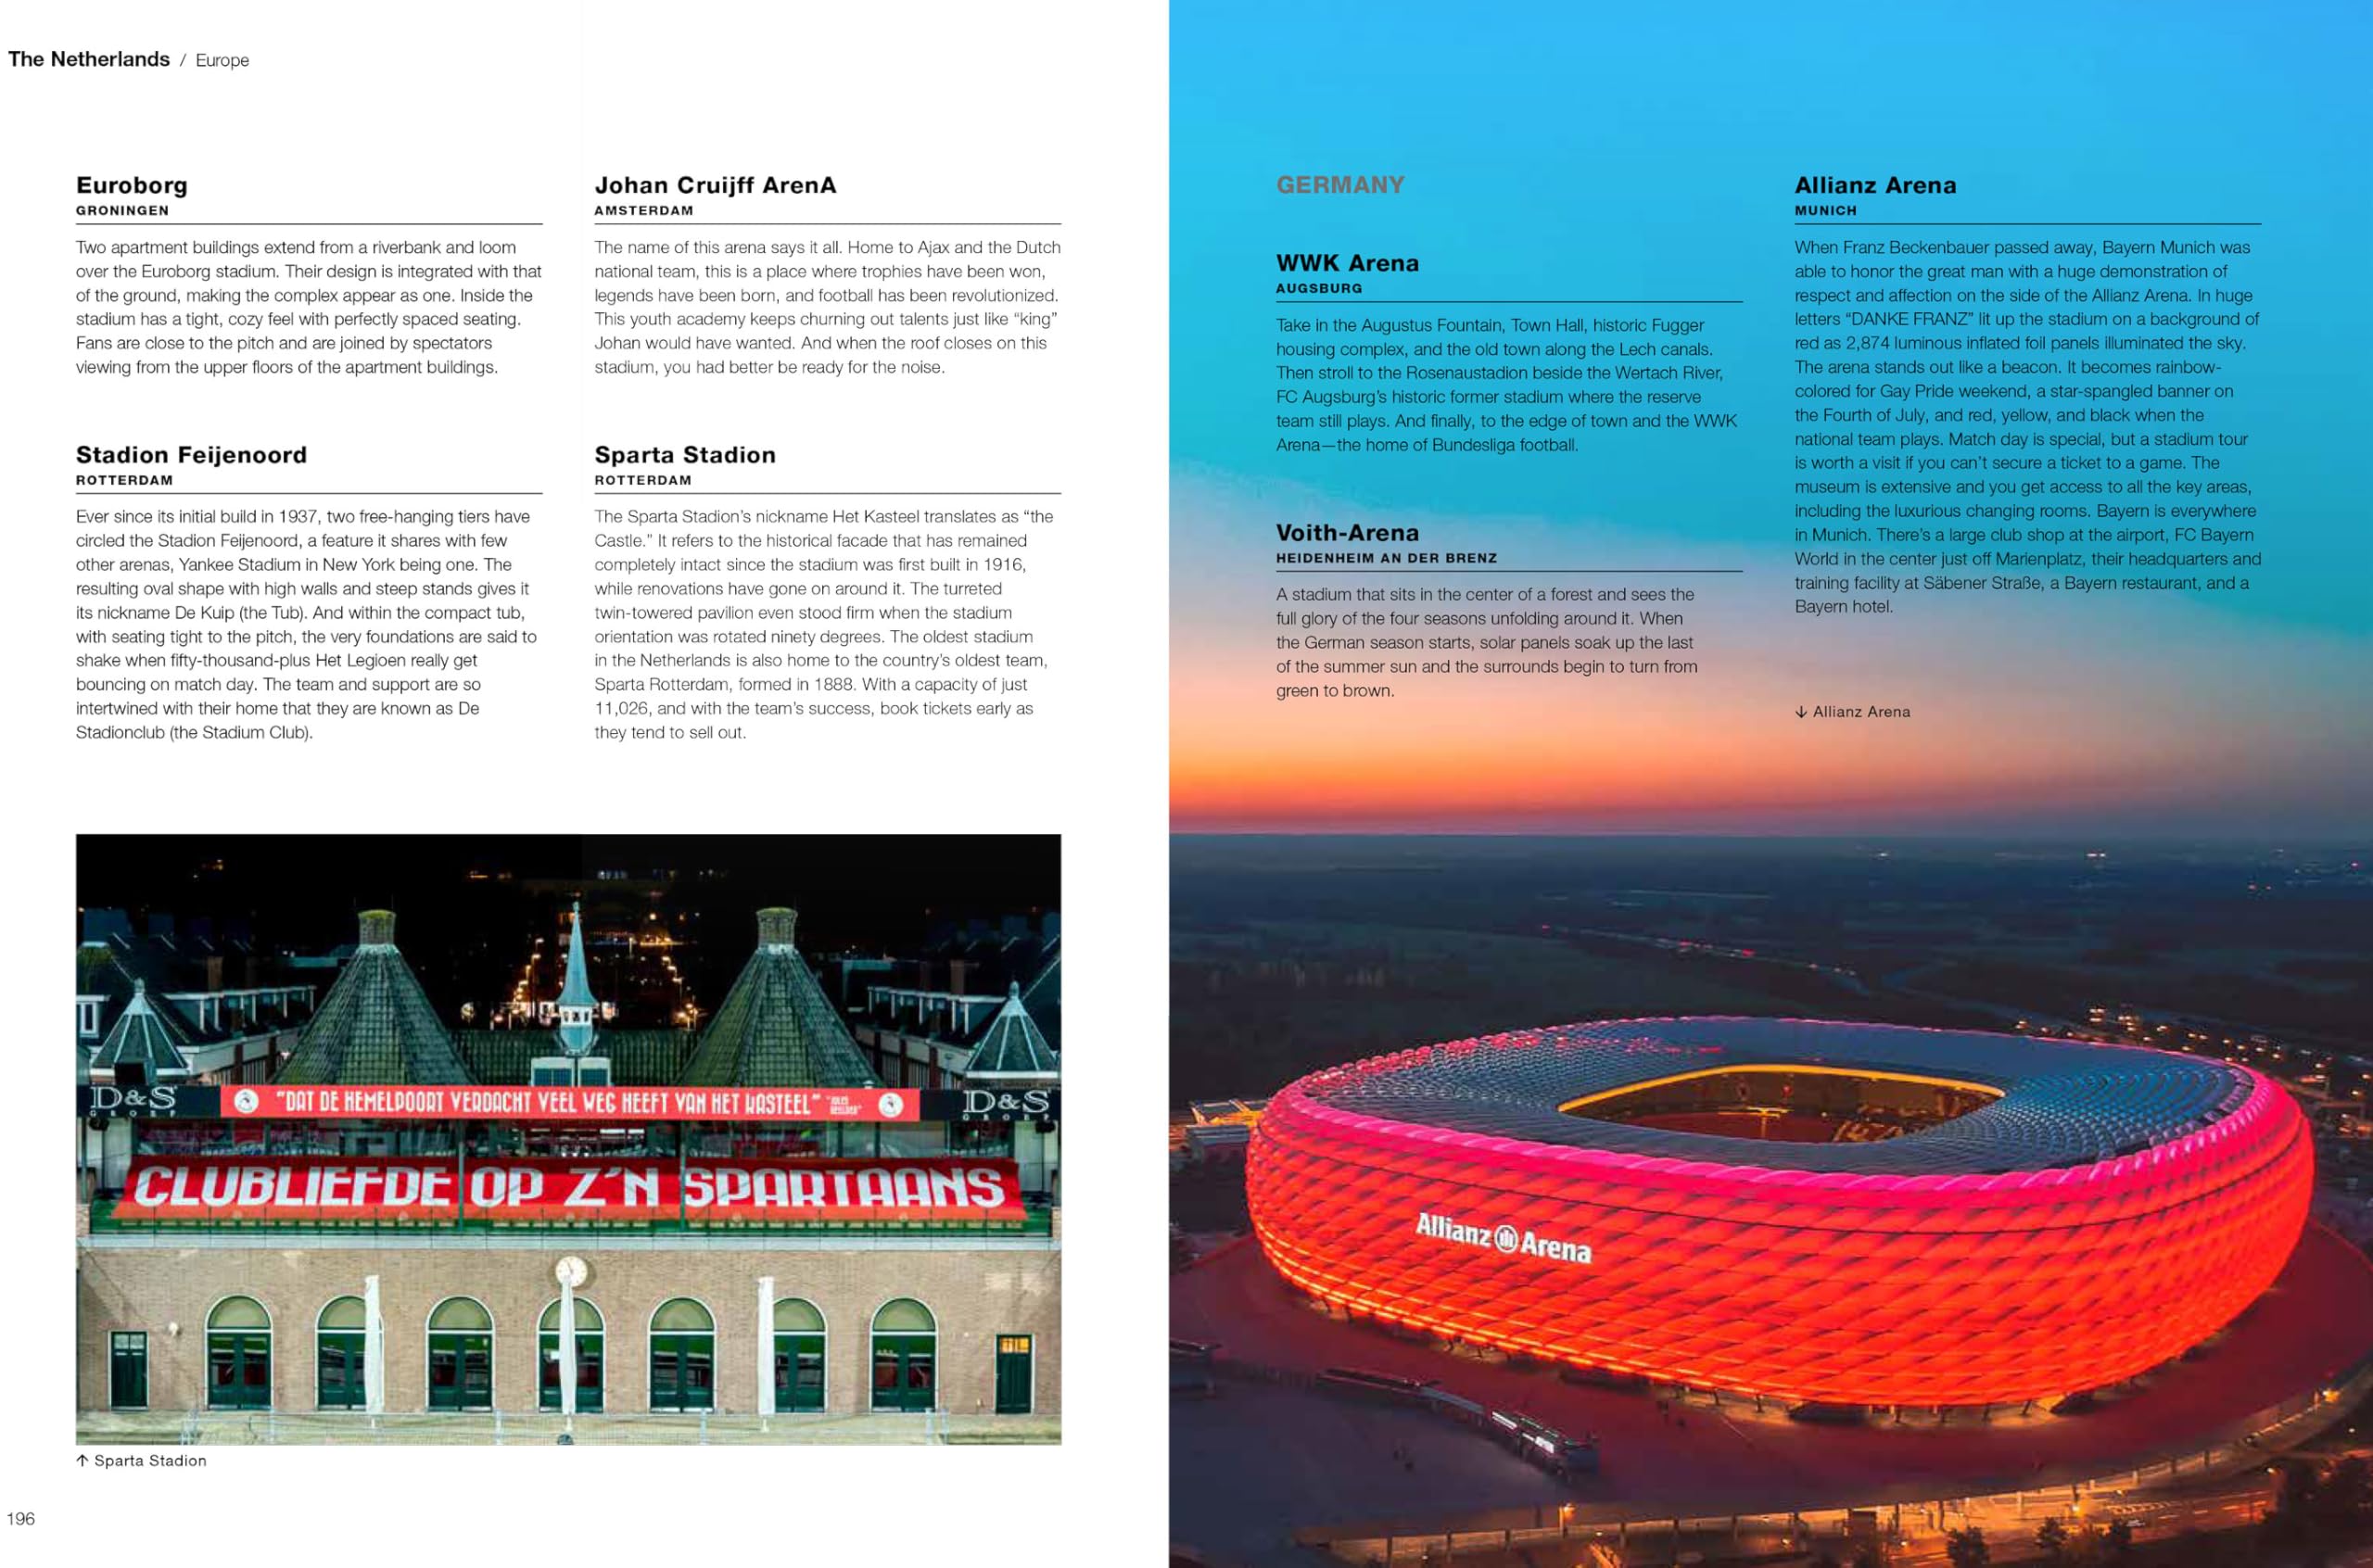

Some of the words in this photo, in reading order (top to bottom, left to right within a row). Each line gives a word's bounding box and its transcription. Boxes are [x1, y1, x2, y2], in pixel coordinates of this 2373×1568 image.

[7, 50, 45, 68] The
[51, 50, 171, 68] Netherlands
[196, 53, 249, 71] Europe
[76, 175, 188, 199] Euroborg
[594, 175, 668, 195] Johan
[677, 175, 755, 198] Cruijff
[762, 175, 838, 195] ArenA
[1276, 174, 1406, 195] GERMANY
[1794, 175, 1877, 195] Allianz
[1884, 175, 1957, 195] Arena
[75, 205, 169, 217] GRONINGEN
[593, 205, 693, 216] AMSTERDAM
[1795, 204, 1857, 216] MUNICH
[74, 239, 107, 255] Two
[110, 241, 189, 259] apartment
[193, 239, 260, 259] buildings
[263, 239, 315, 255] extend
[319, 240, 354, 255] from
[358, 243, 369, 255] a
[373, 239, 442, 255] riverbank
[445, 239, 475, 255] and
[478, 240, 516, 255] loom
[1794, 239, 1839, 255] When
[1843, 239, 1886, 255] Franz
[1889, 240, 1990, 255] Beckenbauer
[1994, 240, 2049, 259] passed
[2053, 243, 2097, 259] away,
[2102, 239, 2156, 259] Bayern
[2160, 239, 2216, 255] Munich
[2219, 243, 2251, 255] was
[1275, 253, 1340, 272] WWK
[1348, 253, 1419, 272] Arena
[594, 288, 654, 307] legends
[658, 288, 694, 303] have
[699, 288, 736, 303] been
[741, 288, 780, 305] born,
[785, 288, 815, 303] and
[818, 287, 873, 303] football
[878, 288, 906, 303] has
[909, 288, 947, 303] been
[952, 288, 1059, 303] revolutionized.
[1275, 283, 1363, 295] AUGSBURG
[593, 311, 626, 326] This
[629, 311, 672, 330] youth
[677, 311, 747, 330] academy
[750, 311, 796, 330] keeps
[800, 311, 866, 330] churning
[869, 312, 895, 326] out
[899, 311, 949, 326] talents
[952, 311, 980, 330] just
[984, 311, 1009, 326] like
[76, 335, 113, 350] Fans
[116, 338, 141, 350] are
[145, 335, 185, 350] close
[188, 336, 205, 350] to
[208, 335, 234, 350] the
[237, 335, 274, 354] pitch
[278, 335, 308, 350] and
[311, 338, 336, 350] are
[338, 335, 385, 354] joined
[389, 335, 409, 354] by
[412, 336, 493, 354] spectators
[1275, 365, 1314, 380] Then
[1318, 364, 1354, 380] stroll
[1357, 366, 1374, 380] to
[1377, 365, 1402, 380] the
[1406, 365, 1529, 380] Rosenaustadion
[1532, 365, 1583, 380] beside
[1586, 365, 1612, 380] the
[1614, 364, 1678, 380] Wertach
[1682, 365, 1723, 382] River,
[1365, 436, 1409, 452] home
[1412, 436, 1428, 452] of
[1432, 436, 1516, 456] Bundesliga
[1519, 436, 1579, 452] football.
[75, 445, 169, 464] Stadion
[178, 445, 307, 468] Feijenoord
[594, 445, 675, 468] Sparta
[682, 445, 776, 464] Stadion
[75, 474, 173, 487] ROTTERDAM
[594, 474, 692, 486] ROTTERDAM
[1795, 503, 1861, 522] including
[1866, 503, 1891, 518] the
[1894, 503, 1961, 518] luxurious
[1965, 503, 2036, 522] changing
[2039, 506, 2091, 518] rooms.
[2097, 503, 2150, 522] Bayern
[2154, 503, 2166, 518] is
[2170, 503, 2257, 522] everywhere
[1275, 523, 1419, 542] Voith-Arena
[594, 557, 677, 575] completely
[680, 557, 722, 572] intact
[726, 557, 766, 572] since
[769, 557, 794, 572] the
[798, 557, 858, 572] stadium
[862, 560, 894, 572] was
[897, 557, 926, 572] first
[930, 557, 961, 572] built
[966, 557, 979, 572] in
[983, 557, 1026, 575] 1916,
[1275, 552, 1375, 564] HEIDENHEIM
[1380, 552, 1402, 564] AN
[1407, 552, 1440, 564] DER
[1445, 552, 1498, 564] BRENZ
[75, 652, 121, 667] shake
[124, 652, 166, 668] when
[170, 652, 311, 671] fifty-thousand-plus
[315, 652, 342, 668] Het
[347, 652, 406, 671] Legioen
[411, 652, 450, 671] really
[452, 653, 478, 671] get
[1275, 686, 1319, 702] green
[1323, 684, 1339, 698] to
[1342, 682, 1395, 698] brown.
[1812, 704, 1863, 718] Allianz
[1867, 704, 1911, 718] Arena
[75, 725, 166, 740] Stadionclub
[170, 725, 198, 743] (the
[202, 725, 265, 740] Stadium
[269, 725, 313, 743] Club).
[594, 725, 628, 743] they
[630, 725, 666, 740] tend
[668, 726, 685, 740] to
[689, 725, 714, 740] sell
[717, 726, 747, 740] out.
[89, 1086, 176, 1109] D&S
[320, 1091, 339, 1112] DE
[450, 1092, 531, 1112] VERDACHT
[538, 1092, 577, 1113] VEEL
[583, 1093, 616, 1113] WEG
[622, 1093, 669, 1114] HEEFT
[675, 1093, 706, 1114] VAN
[712, 1093, 740, 1114] HET
[962, 1089, 1049, 1113] D&S
[134, 1167, 450, 1208] CLUBLIEFDE
[471, 1167, 544, 1208] OP
[684, 1167, 1007, 1208] SPARTAANS
[1415, 1212, 1492, 1247] Allianz
[1520, 1231, 1593, 1264] Arena
[95, 1454, 145, 1471] Sparta
[148, 1453, 207, 1467] Stadion
[6, 1511, 36, 1526] 196
